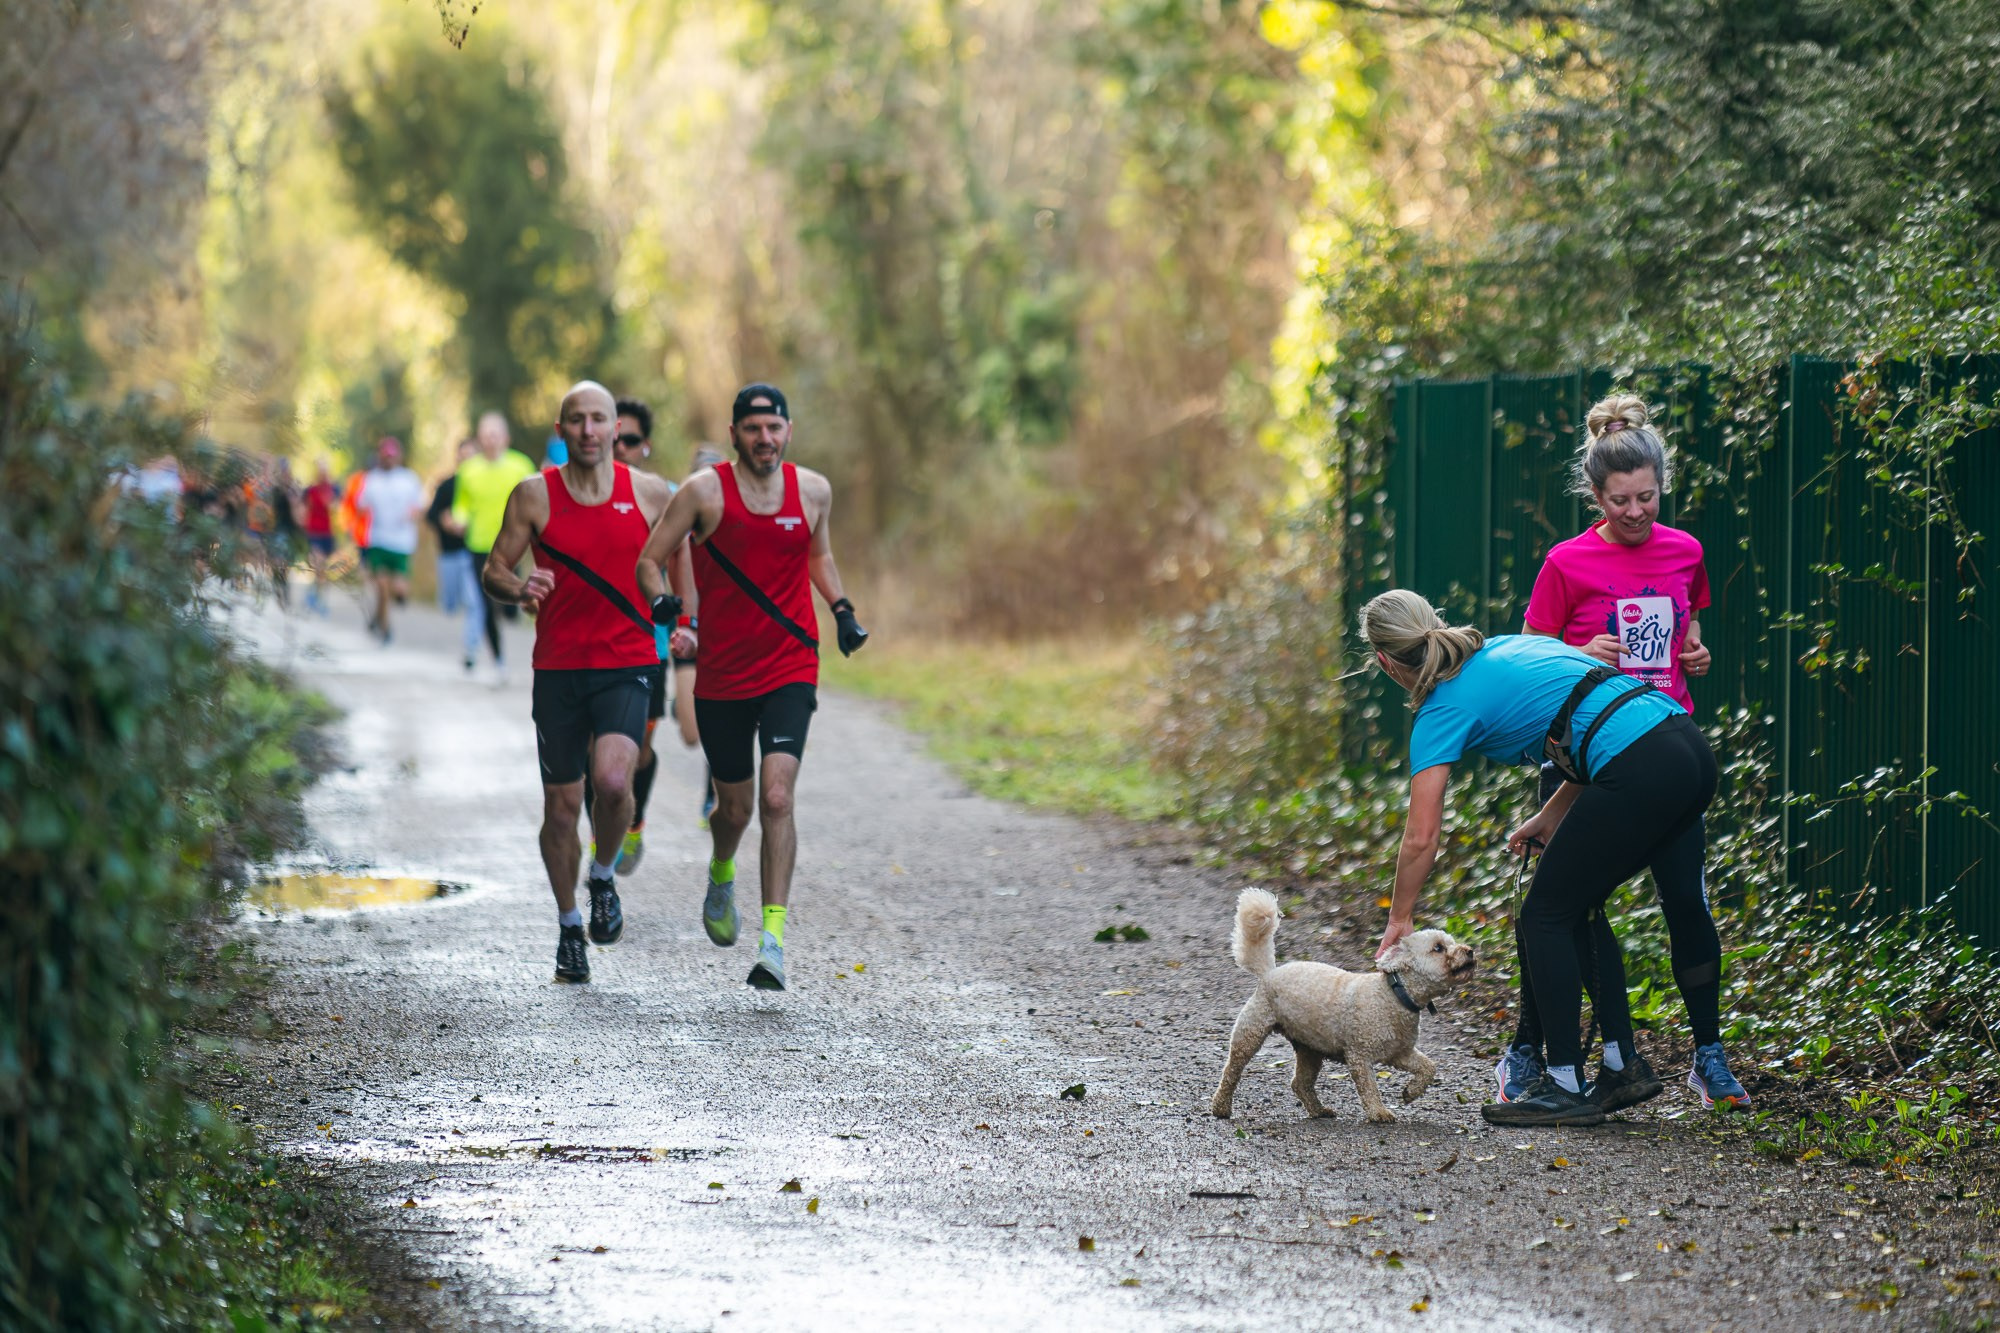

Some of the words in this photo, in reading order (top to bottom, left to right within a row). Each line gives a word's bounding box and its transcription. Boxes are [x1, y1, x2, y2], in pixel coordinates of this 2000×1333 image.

[1622, 609, 1642, 618] Vitality
[1628, 640, 1667, 662] RUN
[1654, 680, 1672, 688] 2025
